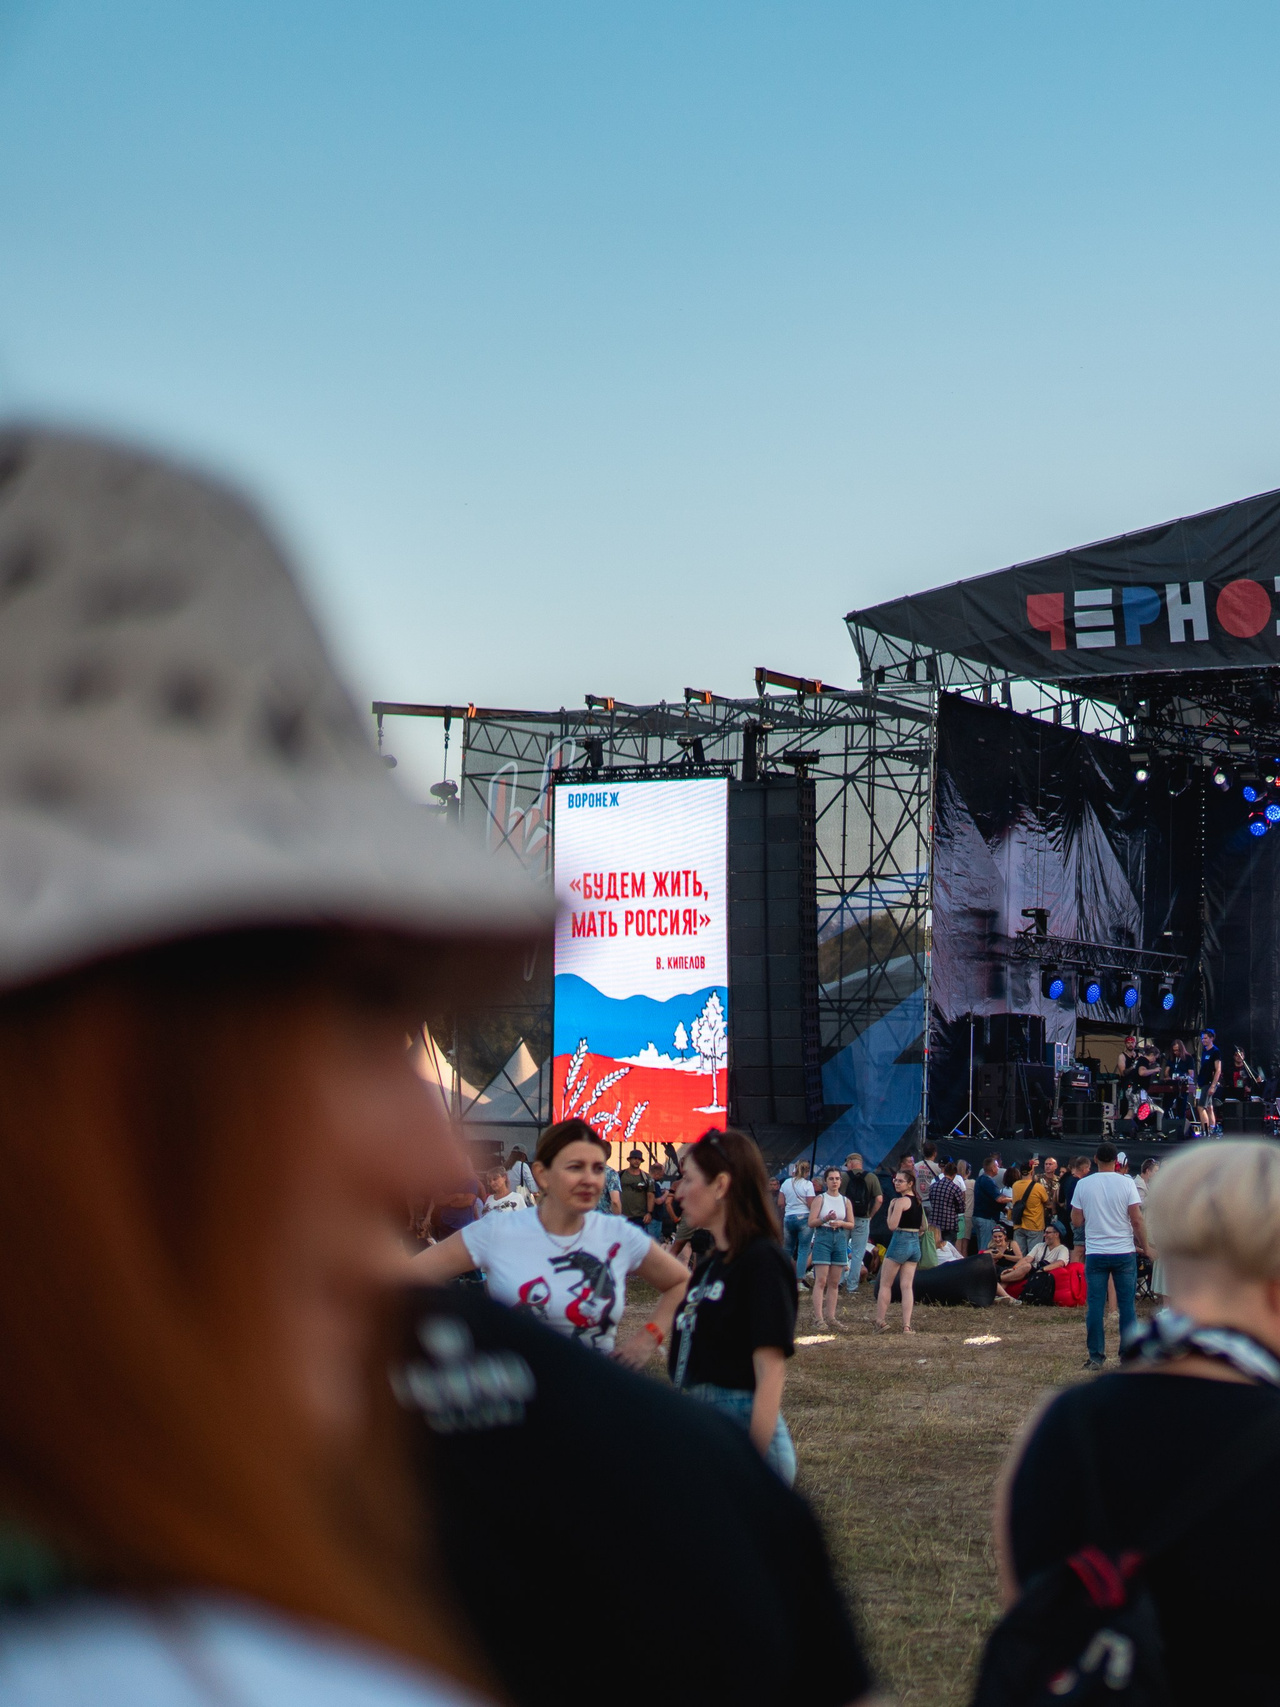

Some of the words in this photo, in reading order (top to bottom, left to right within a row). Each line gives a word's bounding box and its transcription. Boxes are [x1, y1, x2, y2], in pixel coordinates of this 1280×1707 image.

[567, 791, 620, 809] ВОРОНЕЖ
[569, 871, 646, 901] «БУДЕМ
[653, 869, 709, 901] ЖИТЬ,
[571, 910, 618, 938] МАТЬ
[625, 908, 711, 937] РОССИЯ!»
[656, 956, 665, 970] В.
[667, 955, 706, 970] КИПЕЛОВ
